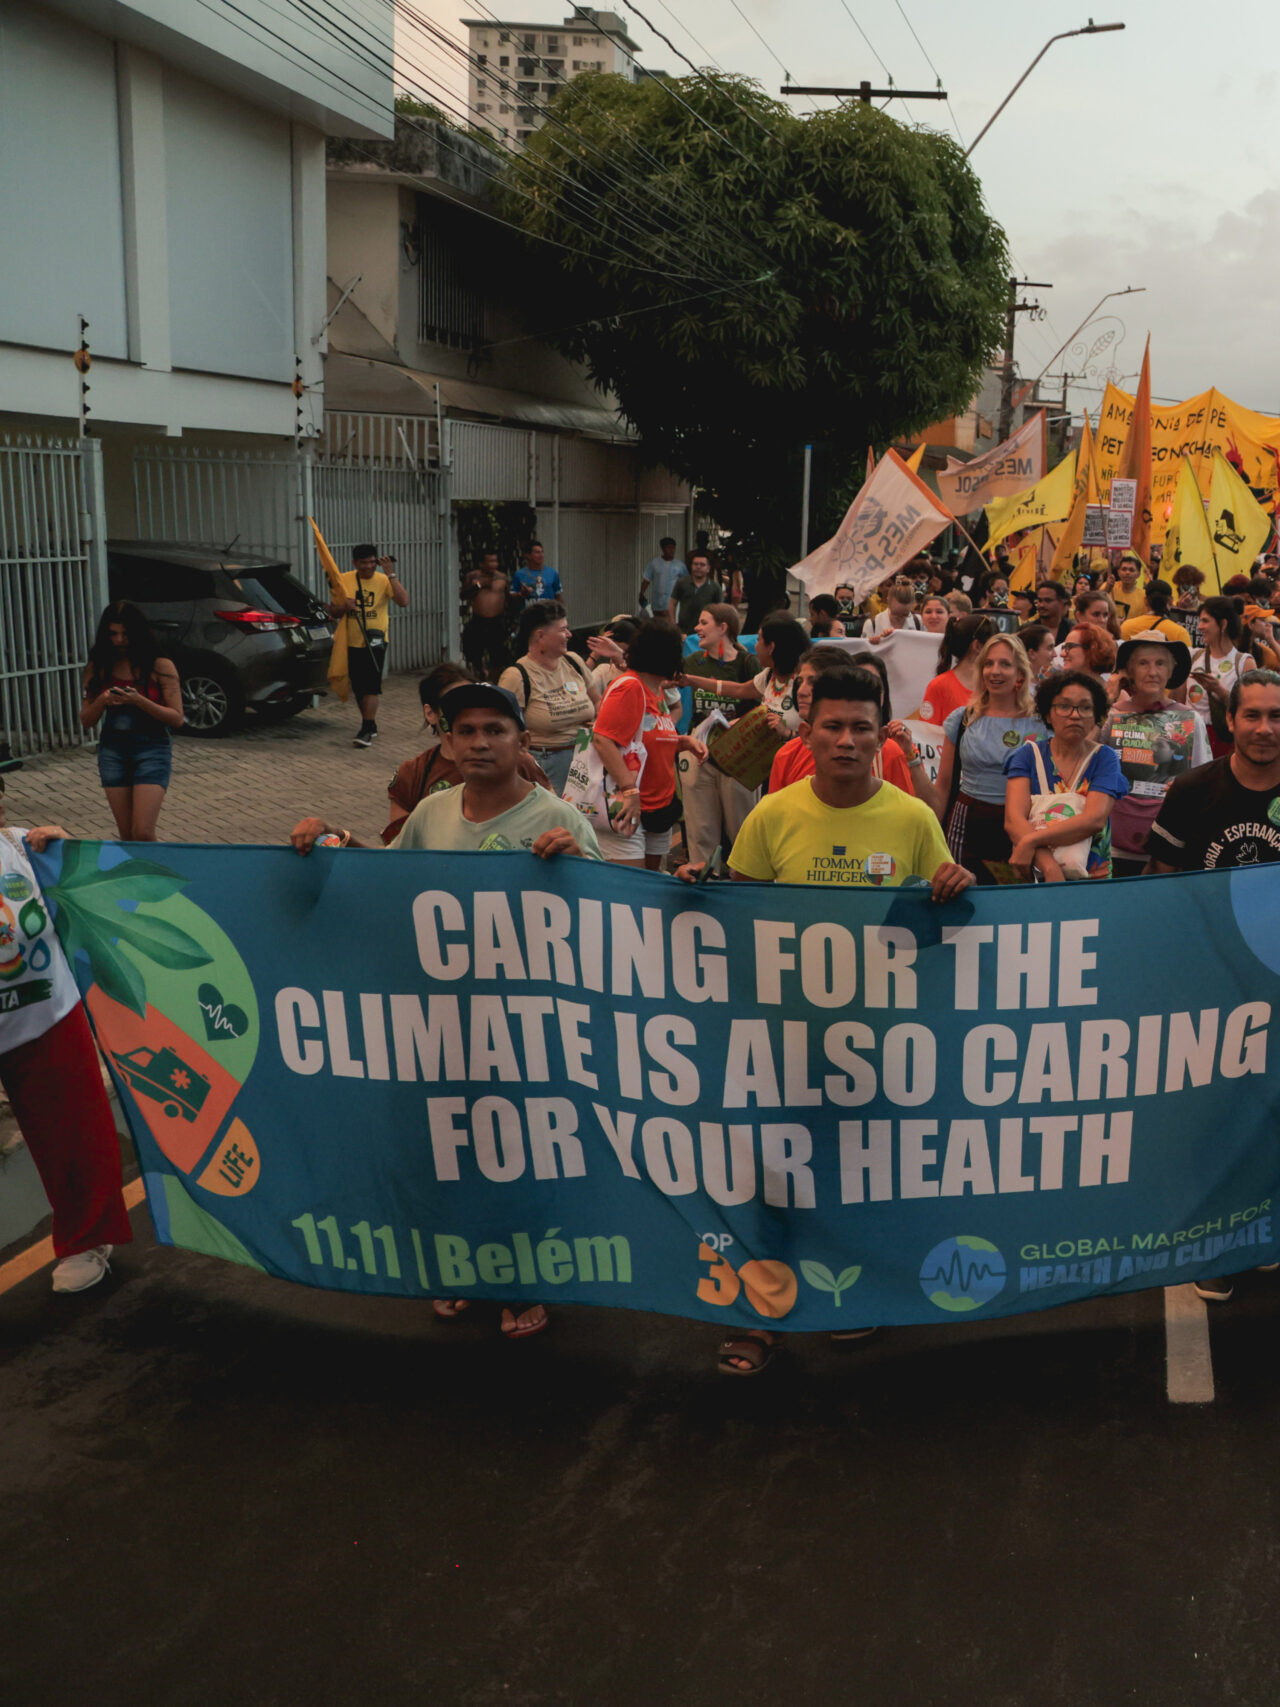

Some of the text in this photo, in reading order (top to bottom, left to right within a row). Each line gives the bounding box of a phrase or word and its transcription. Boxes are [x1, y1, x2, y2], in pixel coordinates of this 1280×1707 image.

[806, 870, 868, 884] HILFIGER
[812, 856, 865, 870] TOMMY
[412, 889, 1100, 1011] CARING FOR THE
[274, 986, 1273, 1109] CLIMATE IS ALSO CARING
[426, 1095, 1134, 1210] FOR YOUR HEALTH
[291, 1212, 633, 1288] 11.11 Belém
[1018, 1215, 1274, 1294] HEALTH AND CLIMATE
[1020, 1198, 1273, 1261] GLOBAL MARCH FOR
